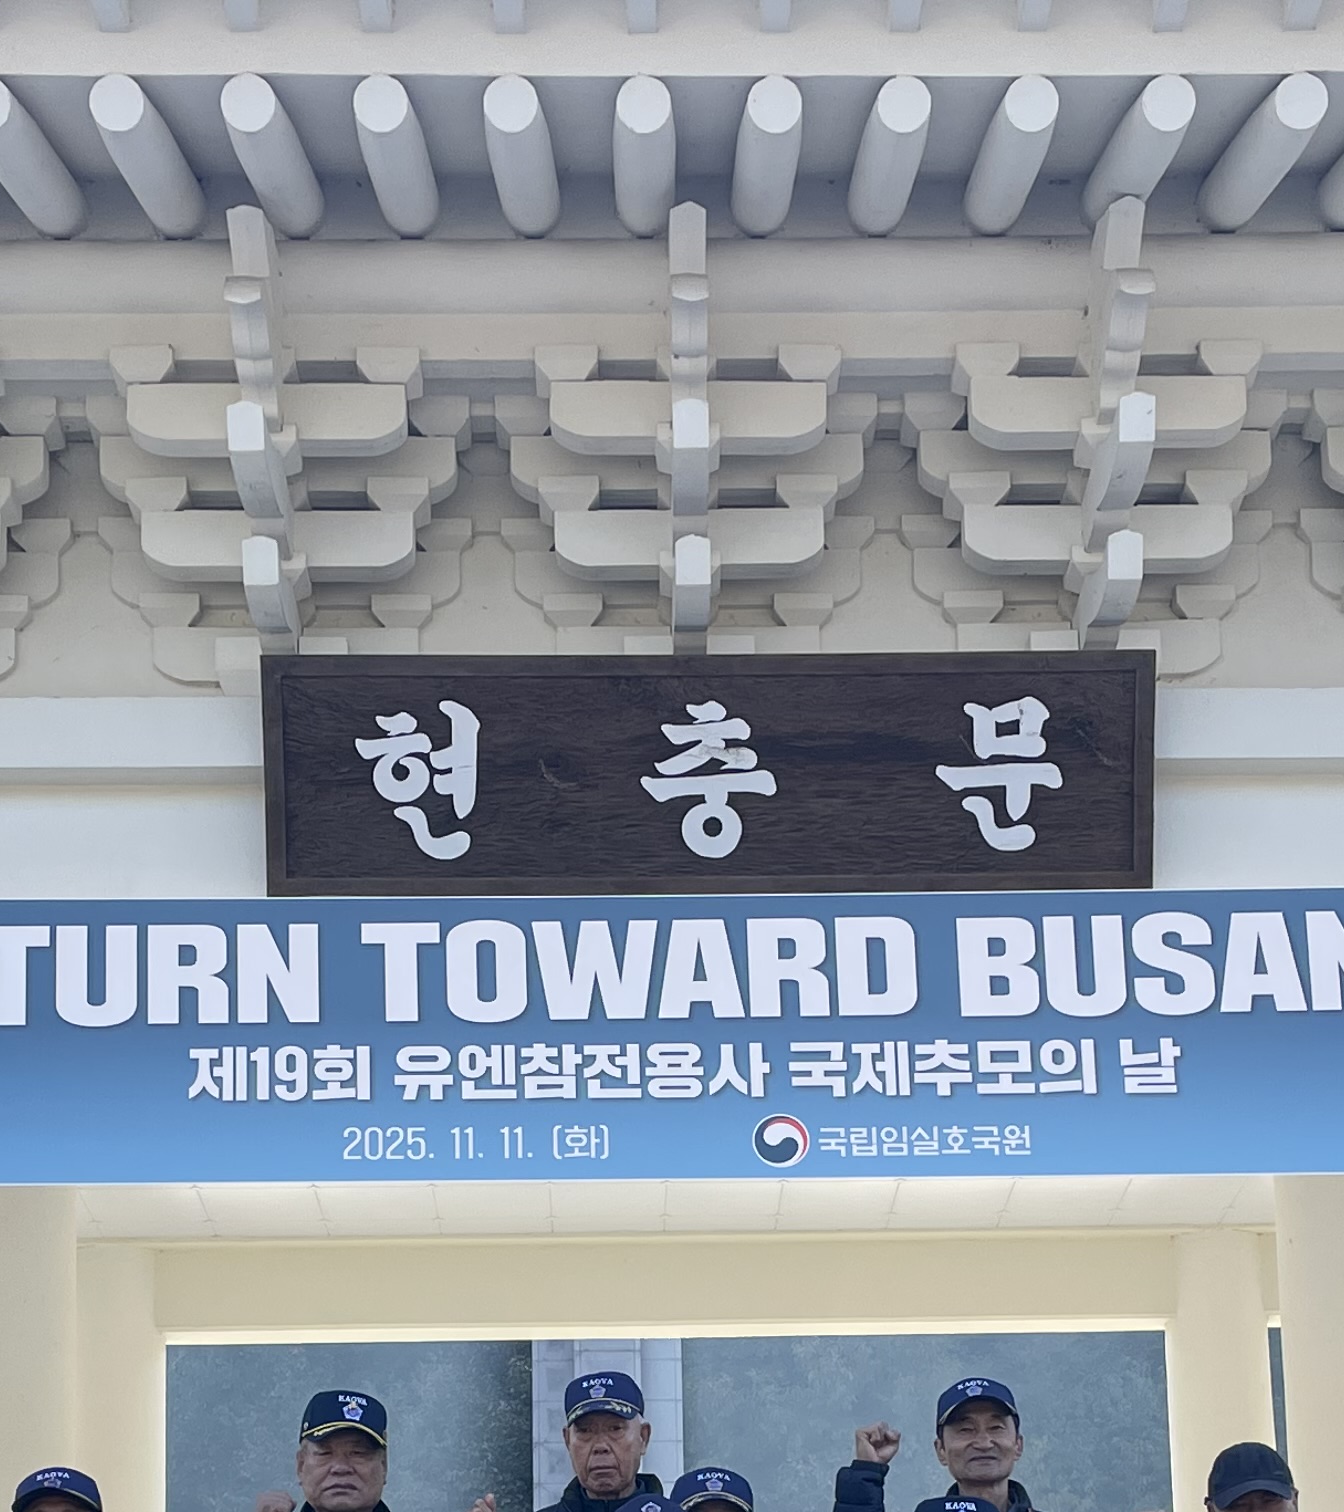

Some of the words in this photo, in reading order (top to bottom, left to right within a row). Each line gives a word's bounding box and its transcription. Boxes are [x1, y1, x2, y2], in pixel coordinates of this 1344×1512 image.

[361, 917, 917, 1023] TOWARD
[188, 1044, 371, 1101] 제19회
[394, 1042, 770, 1100] 유엔참전용사
[788, 1038, 1097, 1097] 국제추모의
[1119, 1037, 1181, 1094] 날
[343, 1126, 434, 1161] 2025.
[450, 1126, 484, 1159] 11.
[500, 1126, 533, 1159] 11.
[552, 1124, 610, 1160] (화)
[818, 1125, 1031, 1158] 국립임실호국원
[582, 1378, 615, 1388] KAOVA
[957, 1380, 989, 1391] KAOVA
[337, 1394, 369, 1406] KAOVA
[36, 1472, 70, 1482] KAOVA
[697, 1472, 731, 1482] KAOVA
[945, 1501, 976, 1511] KAOVA
